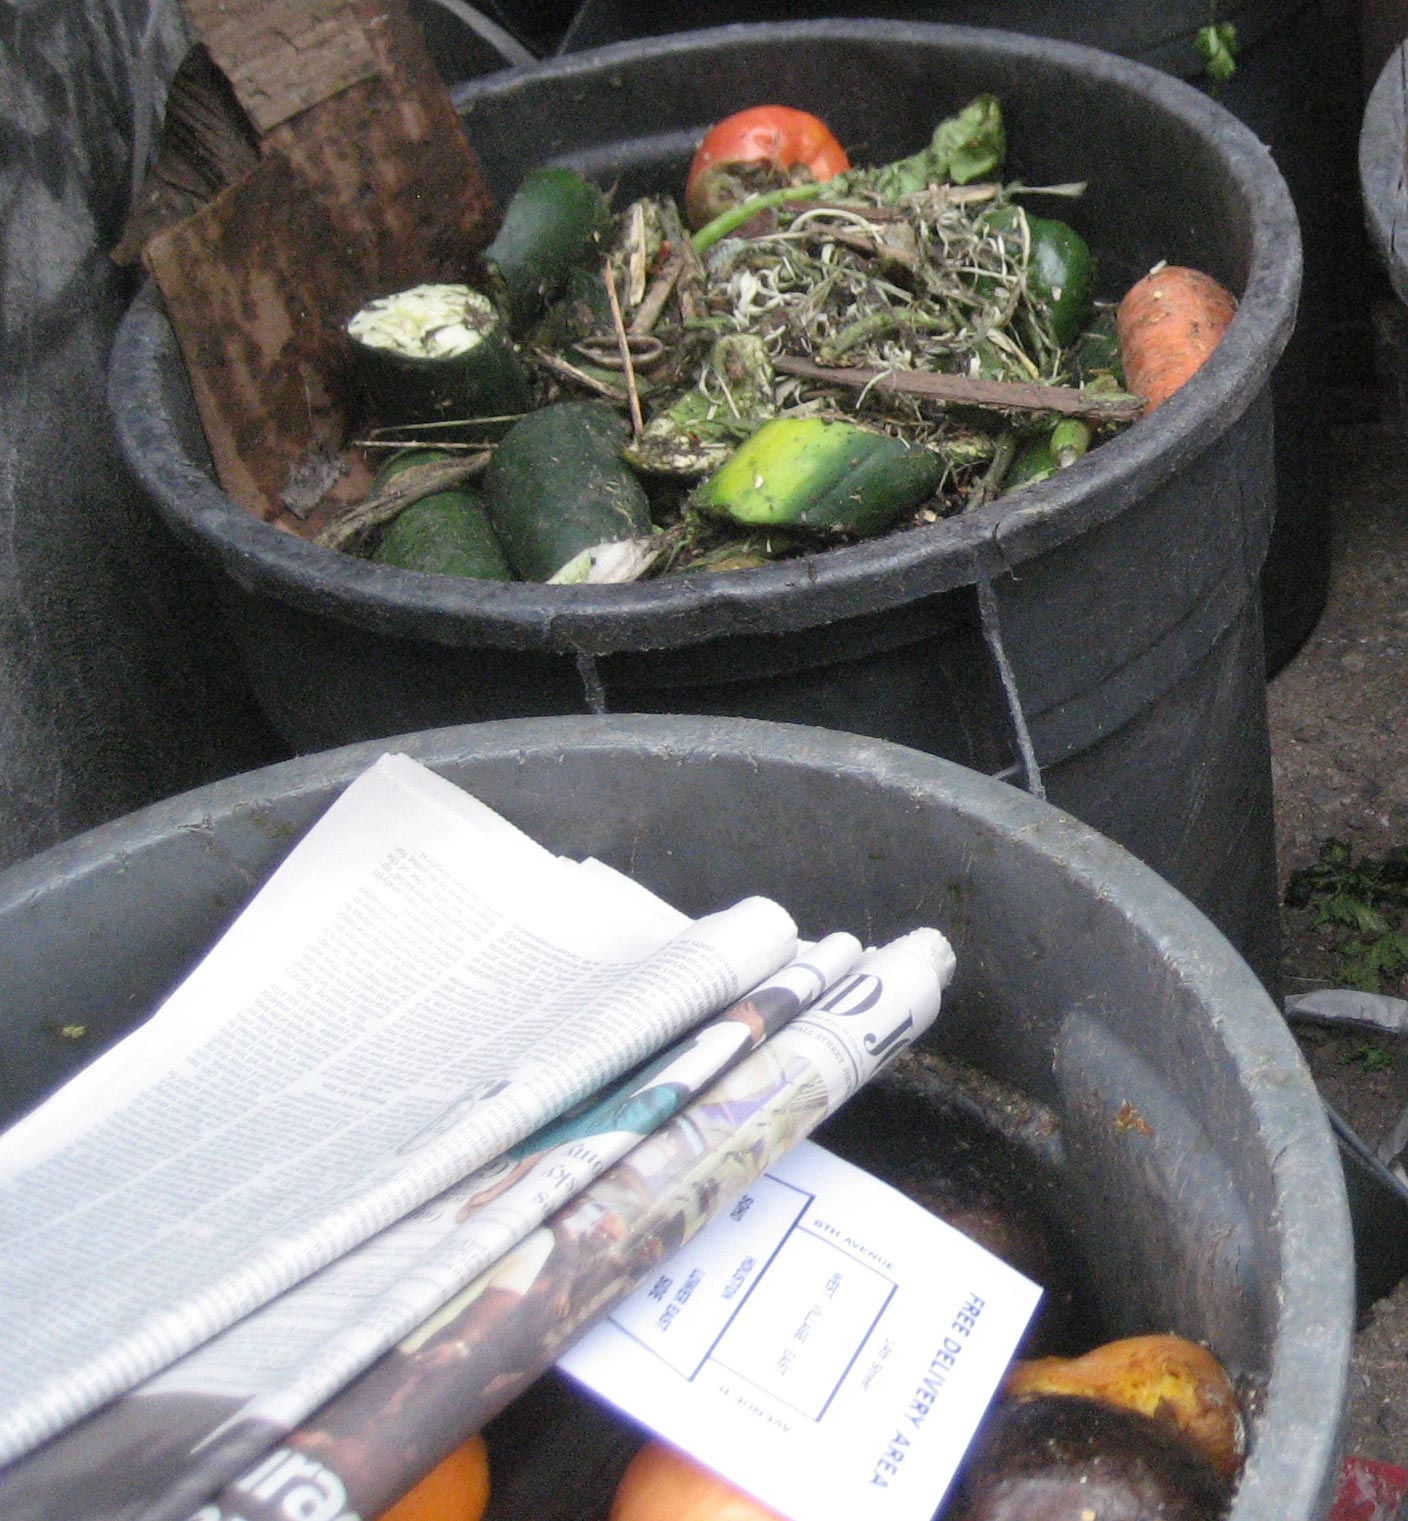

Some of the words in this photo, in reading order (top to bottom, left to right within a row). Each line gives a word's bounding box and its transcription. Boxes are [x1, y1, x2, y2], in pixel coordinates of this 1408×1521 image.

[730, 1194, 754, 1222] SOHO
[844, 1237, 894, 1270] AVENUE
[648, 1275, 674, 1303] SIDE
[673, 1268, 705, 1305] LOWER
[721, 1255, 757, 1299] HOUSTON
[824, 1271, 843, 1300] WEST
[656, 1303, 682, 1332] EAST
[793, 1304, 822, 1344] VILLAGE
[952, 1292, 985, 1337] FREE
[776, 1347, 797, 1376] EAST
[904, 1337, 962, 1429] DELIVERY
[869, 1429, 911, 1488] AREA
